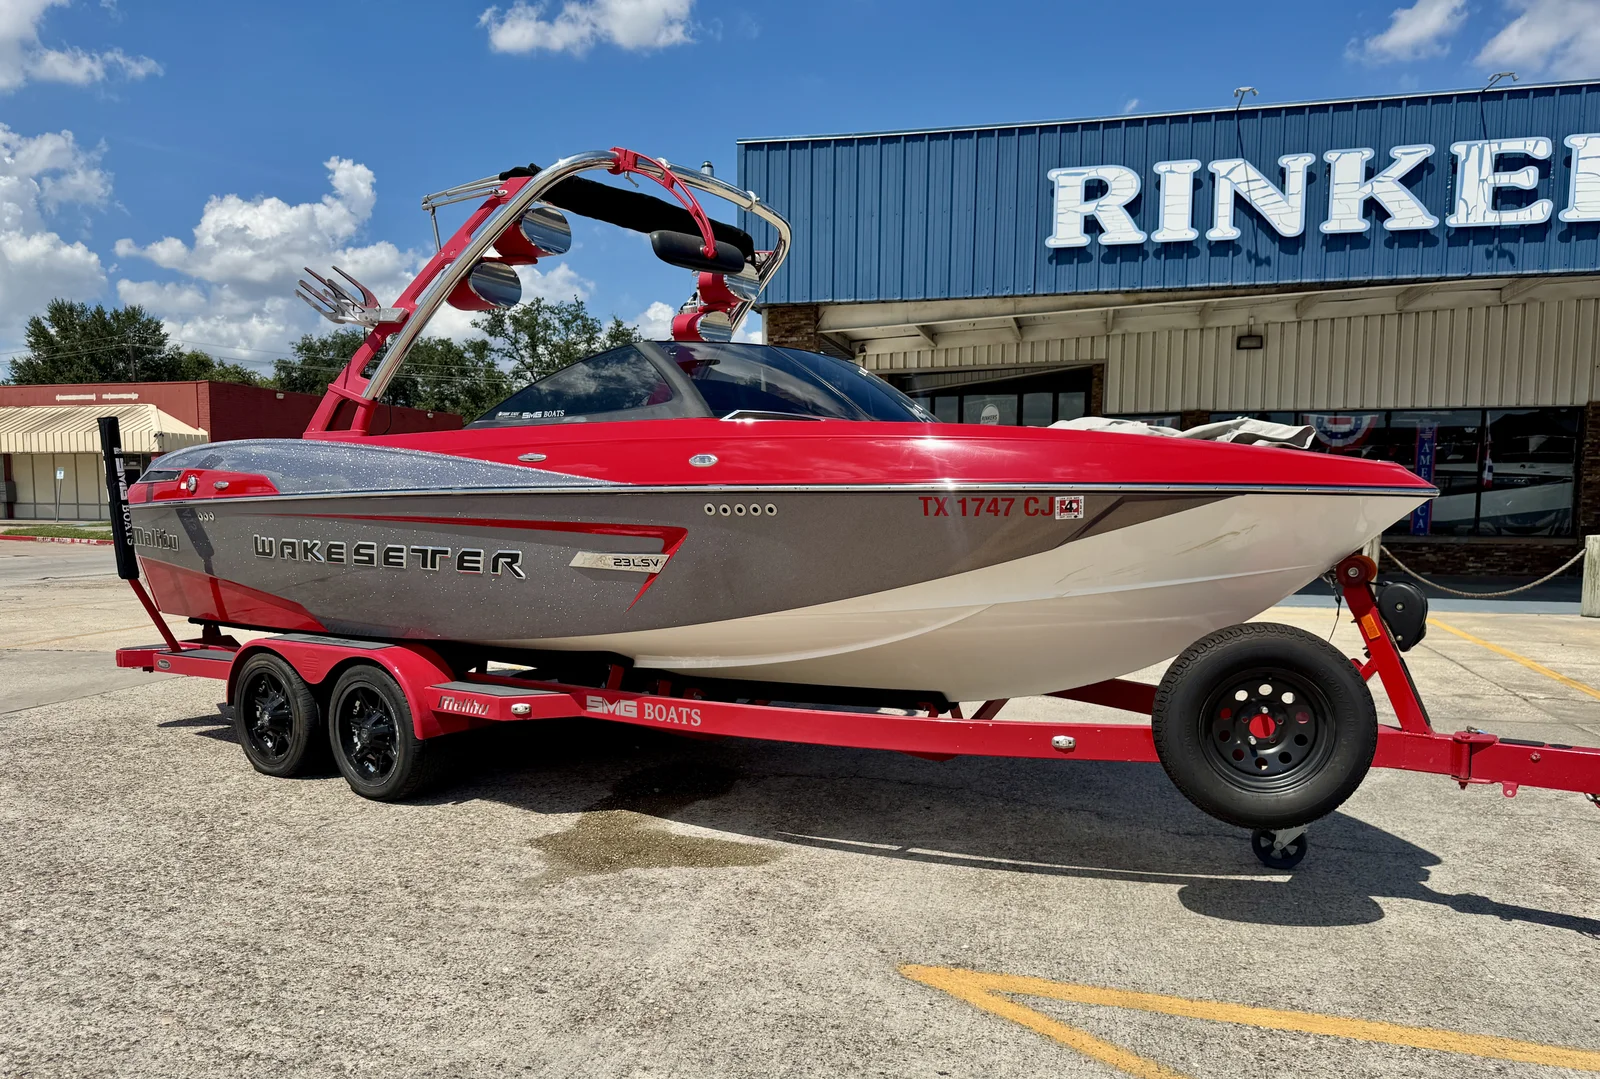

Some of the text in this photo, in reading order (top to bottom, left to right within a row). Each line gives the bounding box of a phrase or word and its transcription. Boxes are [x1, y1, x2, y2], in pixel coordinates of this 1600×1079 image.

[521, 411, 542, 419] SMG
[543, 409, 565, 418] BOATS
[1416, 442, 1431, 529] AMECA
[918, 496, 949, 516] TX
[957, 497, 1015, 516] 1747
[1023, 496, 1055, 517] CJ
[1064, 500, 1074, 513] 4
[121, 503, 134, 546] BOATS
[132, 526, 179, 552] Malibu
[253, 534, 526, 580] WAKESETTER
[613, 558, 660, 567] 23LSV
[437, 696, 490, 716] Malibu
[586, 695, 702, 727] SMG BOATS
